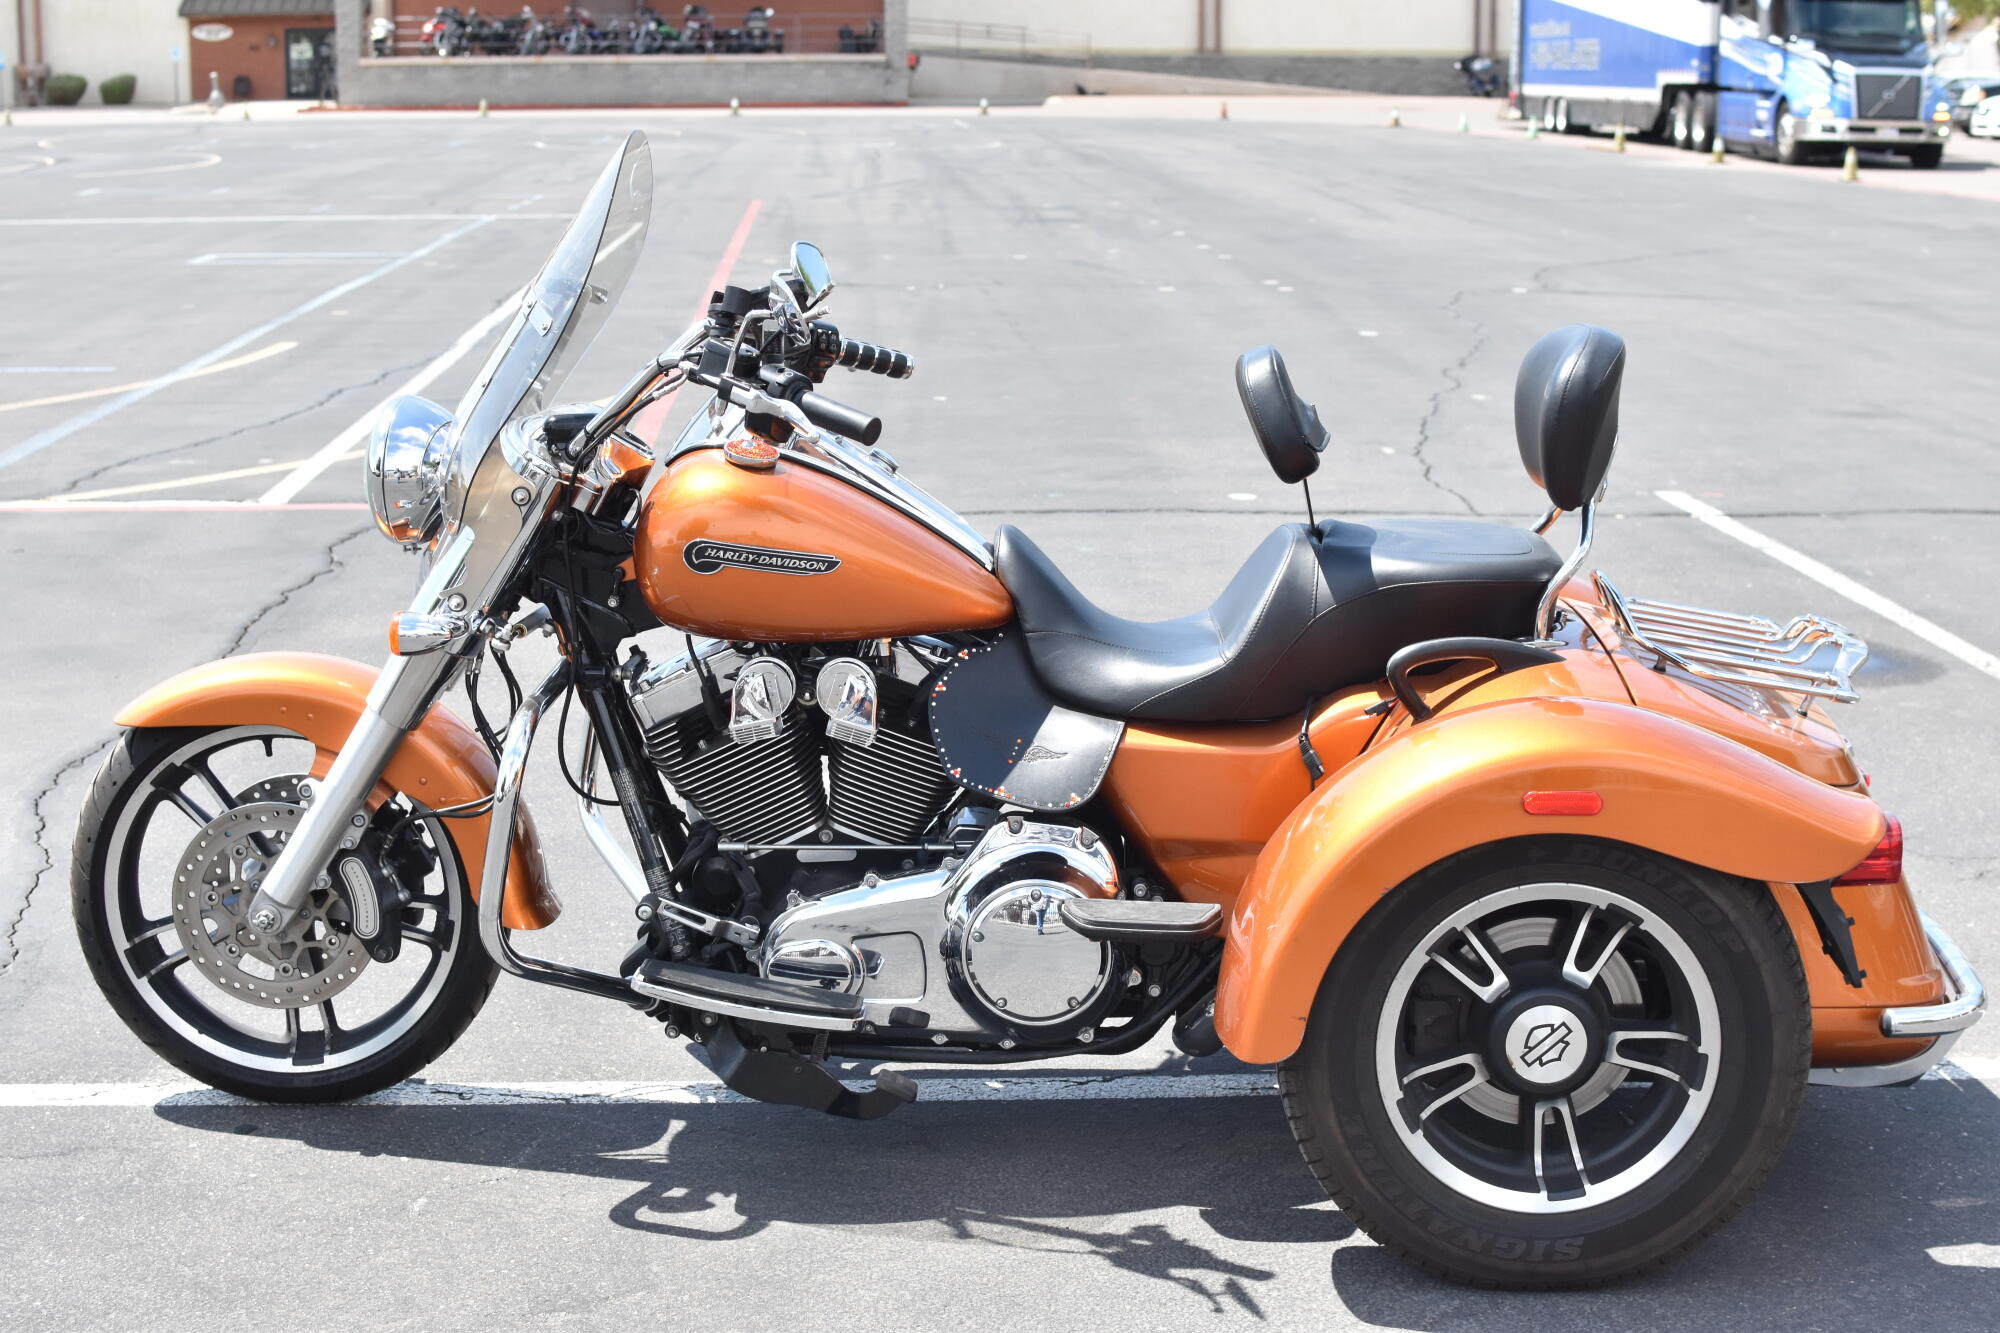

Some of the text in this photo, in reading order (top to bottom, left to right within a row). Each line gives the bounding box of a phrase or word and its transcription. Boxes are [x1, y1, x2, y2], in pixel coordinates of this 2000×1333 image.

[704, 547, 829, 571] HARLEY-DAVIDSON
[1567, 841, 1746, 953] DUNLOP
[1341, 1115, 1586, 1263] SIGNATURE
